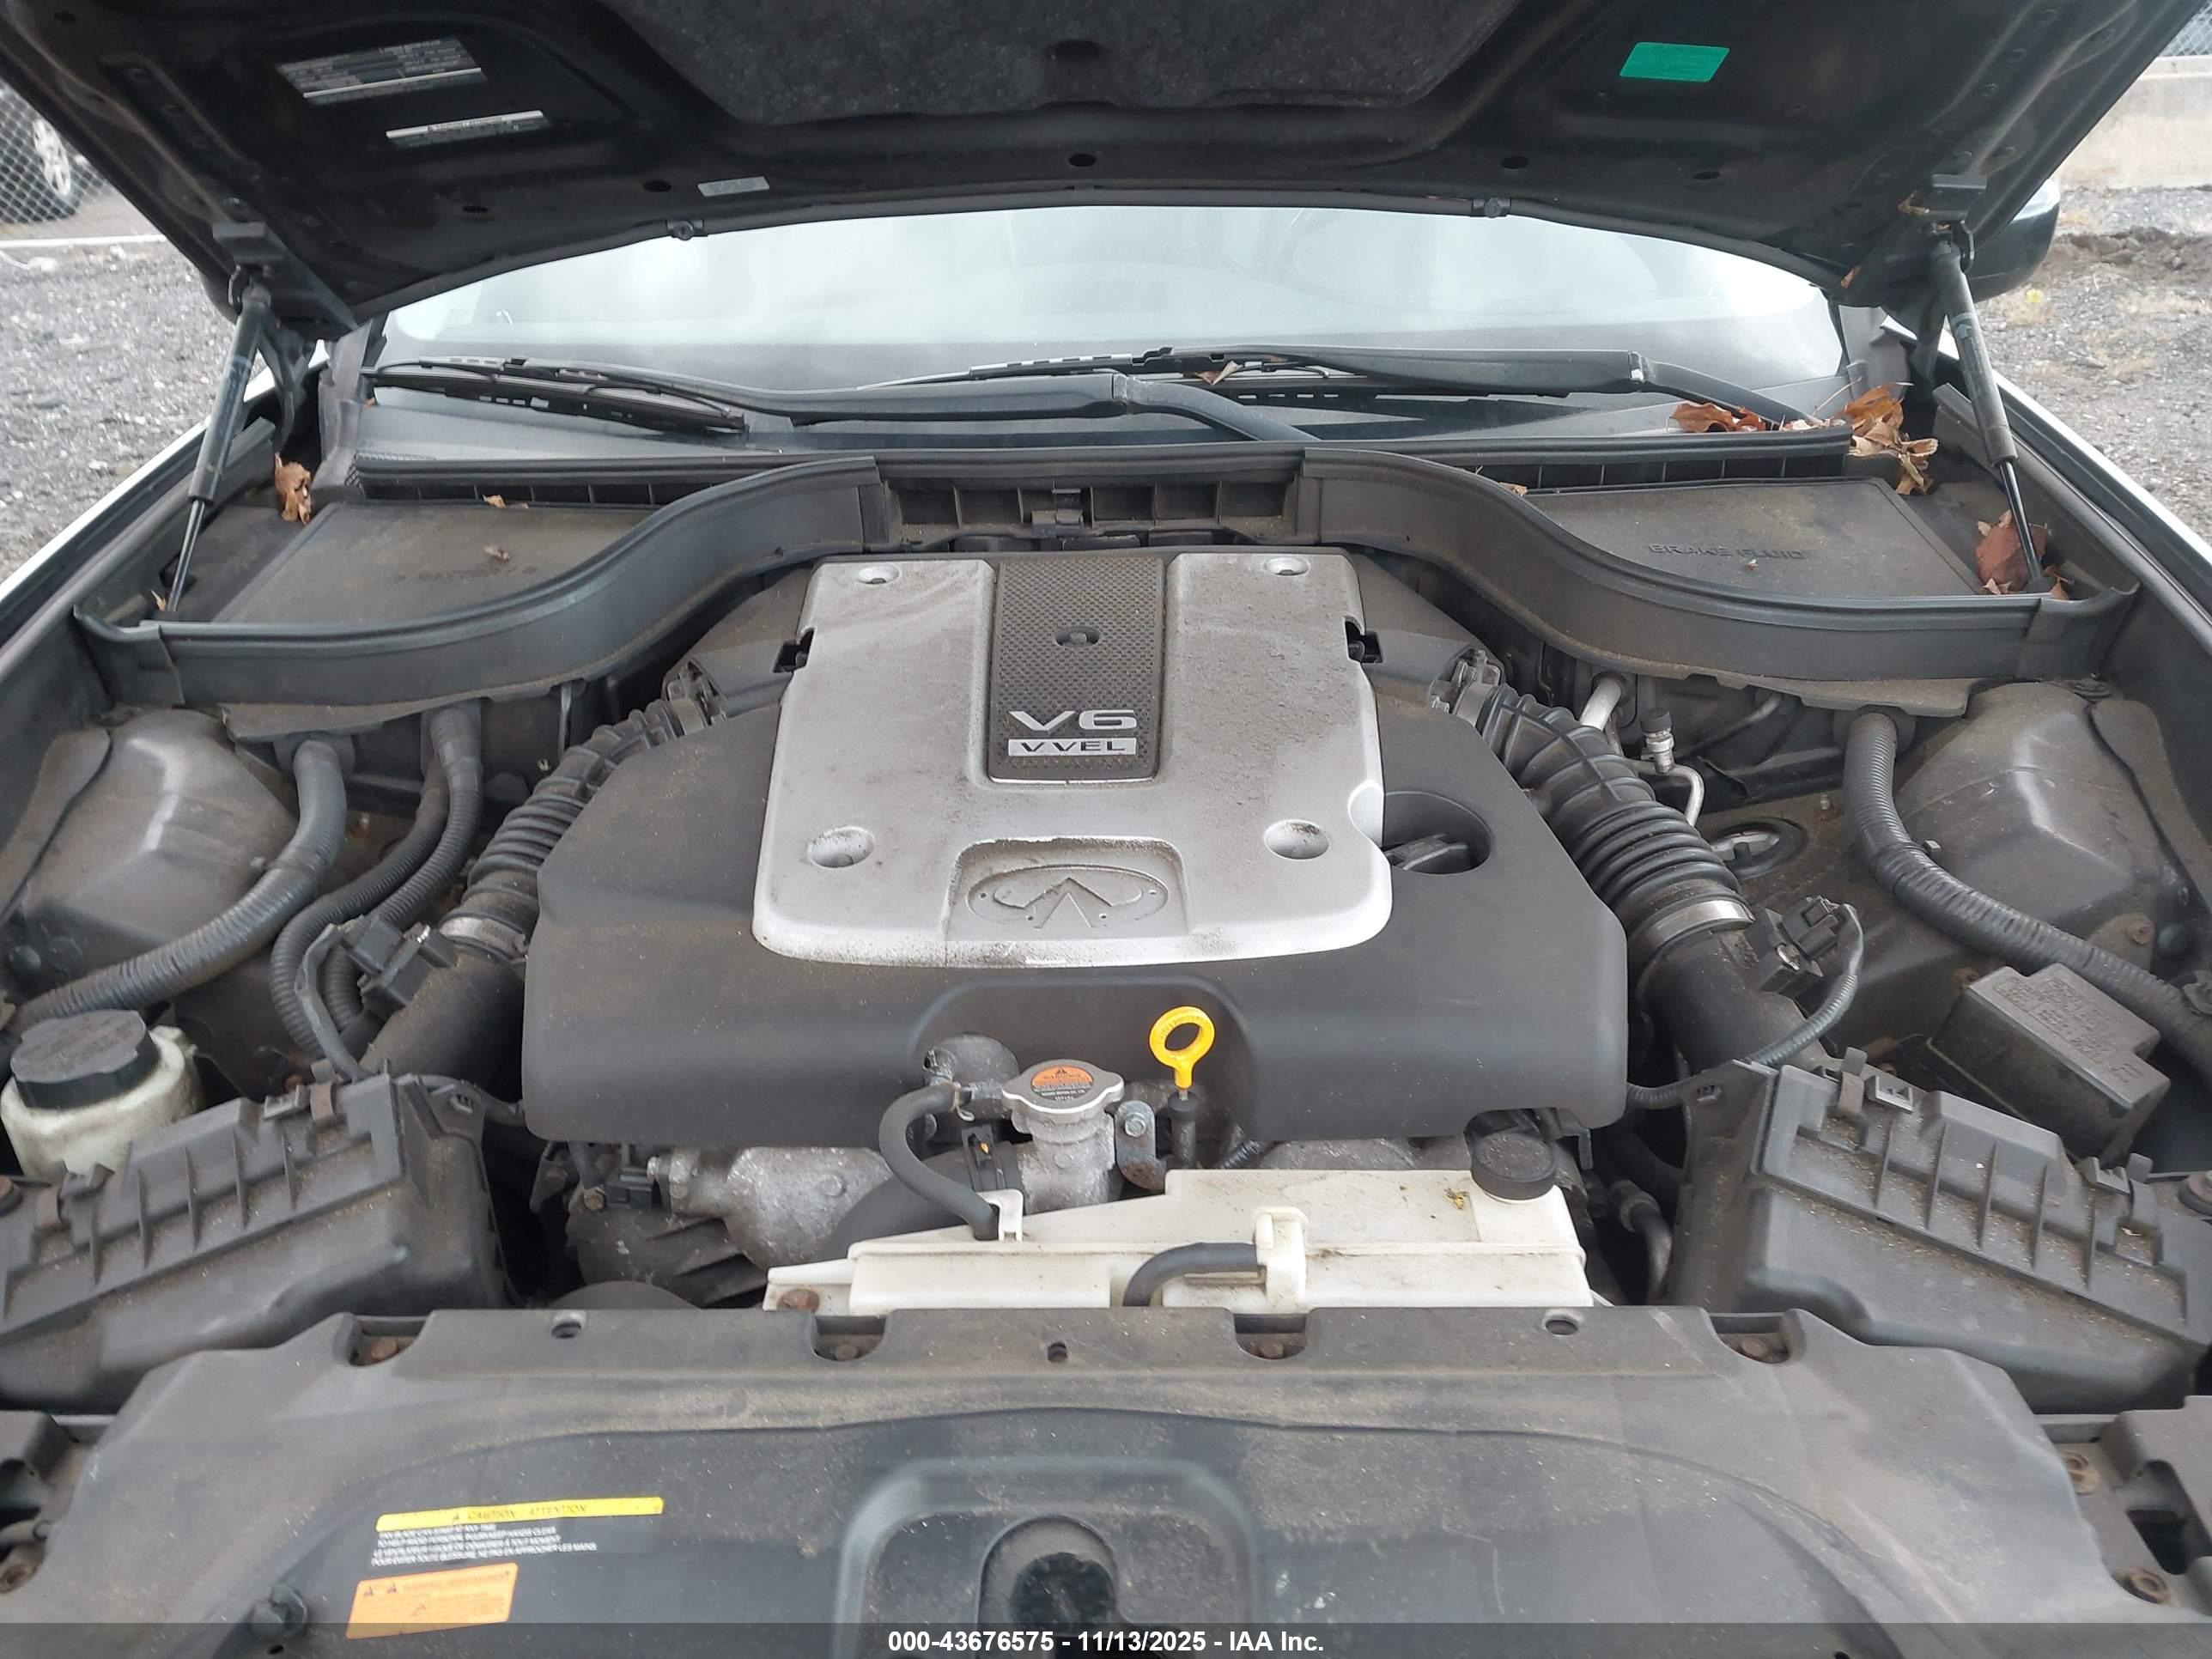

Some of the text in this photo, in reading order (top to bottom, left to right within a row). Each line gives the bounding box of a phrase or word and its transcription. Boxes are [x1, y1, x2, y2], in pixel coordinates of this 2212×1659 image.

[1736, 548, 1808, 560] FLUID
[1008, 709, 1137, 732] V6
[1020, 740, 1126, 752] VVEL
[467, 1504, 588, 1521] CAUTION ATTENTION
